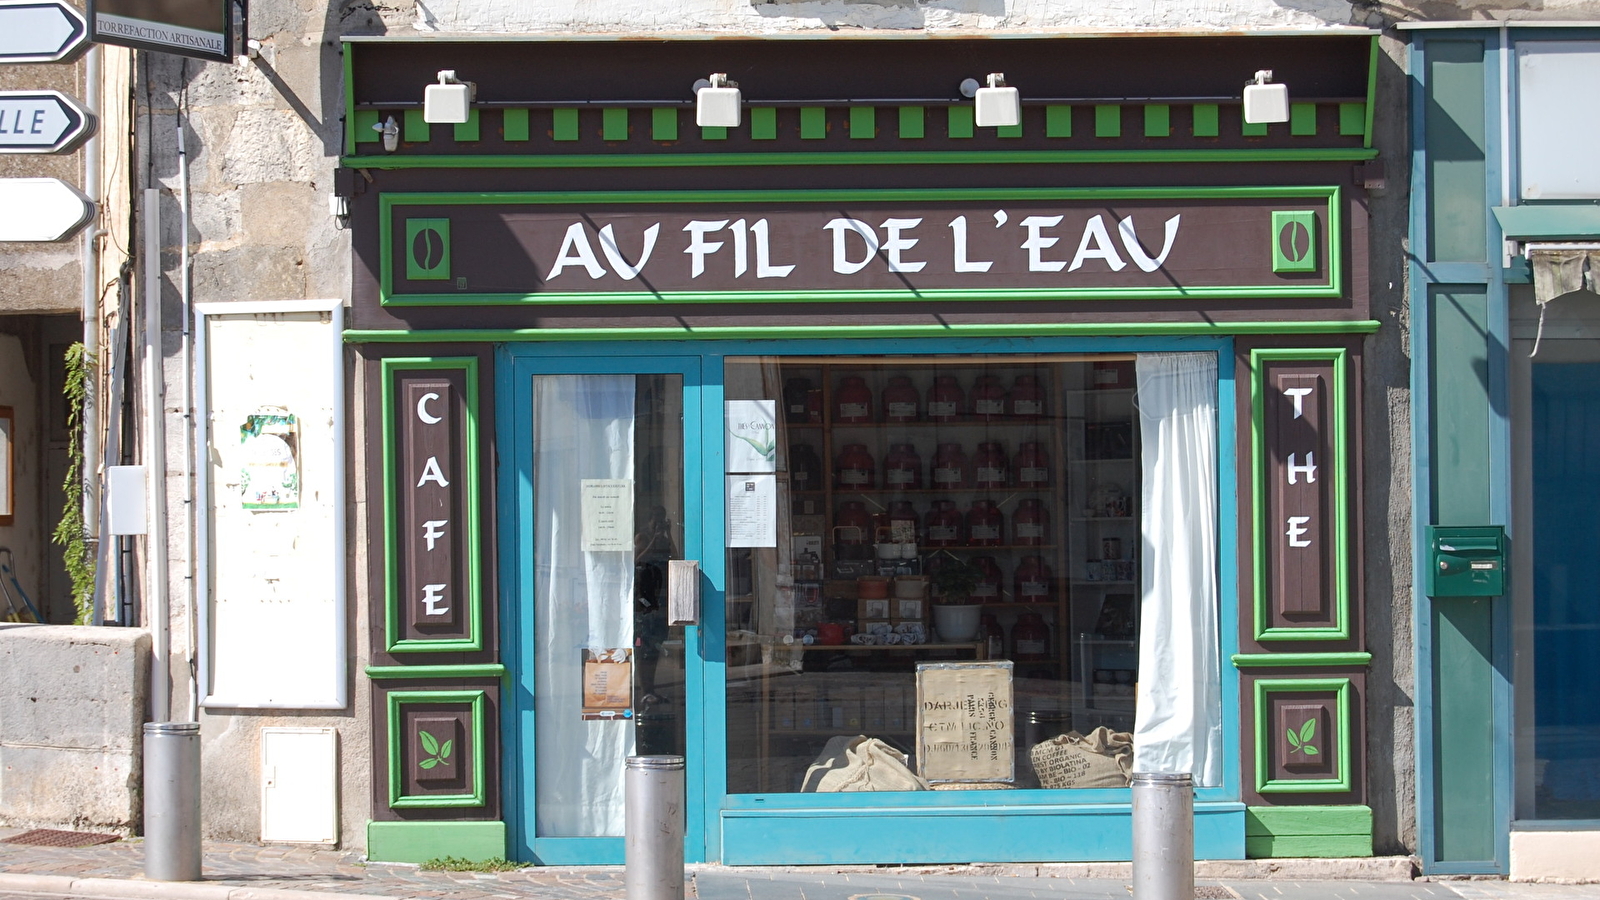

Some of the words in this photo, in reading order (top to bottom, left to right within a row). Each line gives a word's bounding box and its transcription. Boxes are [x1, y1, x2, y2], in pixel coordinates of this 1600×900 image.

[98, 20, 169, 42] TORREFACTION
[169, 32, 222, 51] ARTISANALE
[545, 222, 660, 281] AU
[682, 218, 796, 279] FIL
[823, 217, 927, 274] DE
[948, 209, 1181, 273] L'EAU
[1283, 387, 1318, 548] THE
[416, 392, 450, 616] CAFE
[1048, 752, 1082, 766] ORGANIC
[1048, 757, 1087, 772] BIOLATINA
[1063, 766, 1077, 775] BIO
